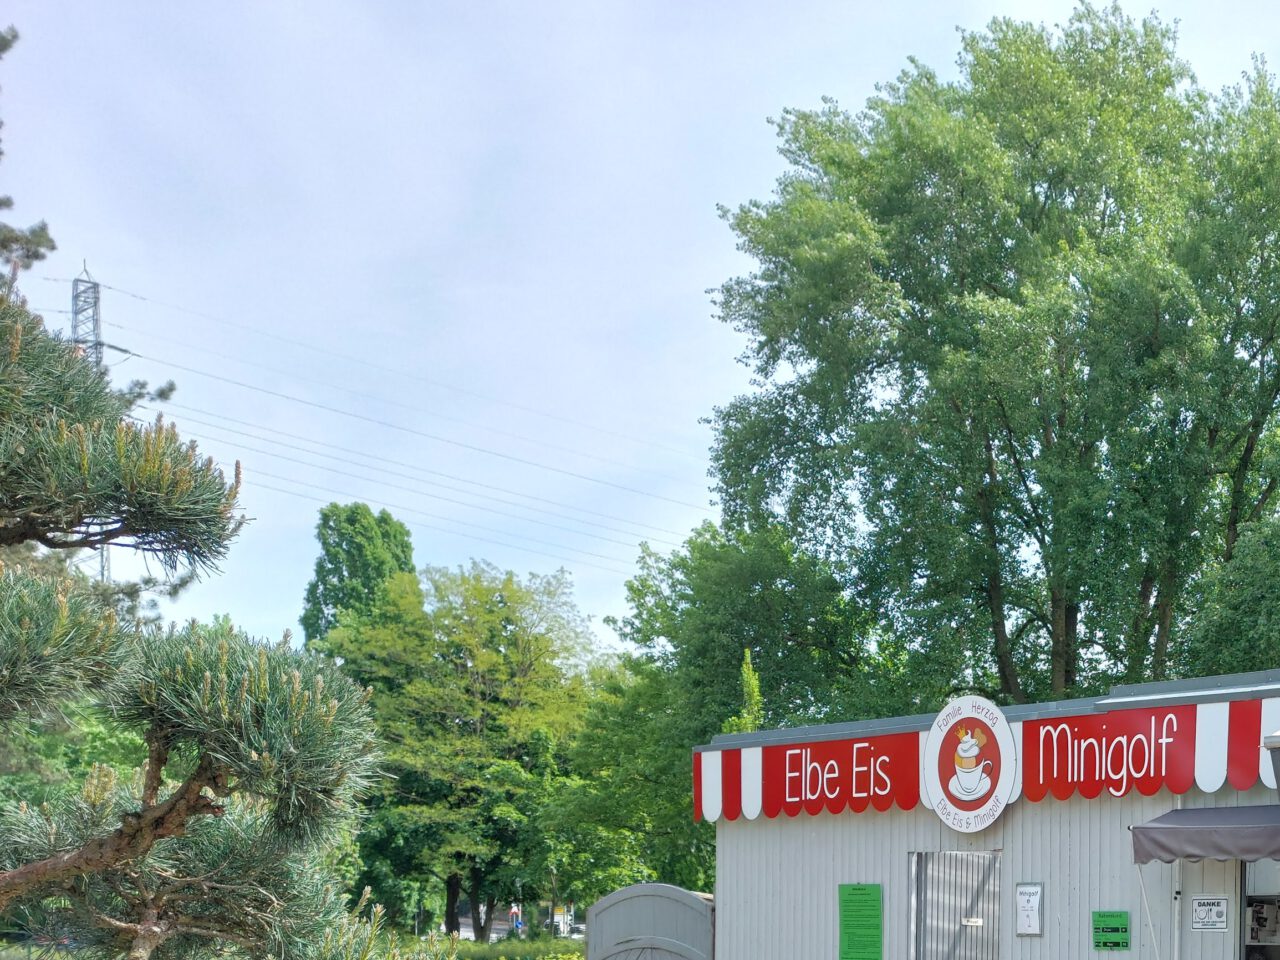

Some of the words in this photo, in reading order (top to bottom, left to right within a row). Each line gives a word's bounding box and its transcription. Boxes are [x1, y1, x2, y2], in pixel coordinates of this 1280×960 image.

[936, 705, 963, 732] Familie
[971, 700, 999, 728] Herzog
[784, 748, 840, 802] Elbe
[851, 741, 892, 798] Eis
[1038, 712, 1178, 798] Minigolf
[936, 798, 951, 820] Elbe
[952, 810, 963, 829] Eis
[965, 816, 972, 829] &
[973, 795, 1002, 828] Minigolf
